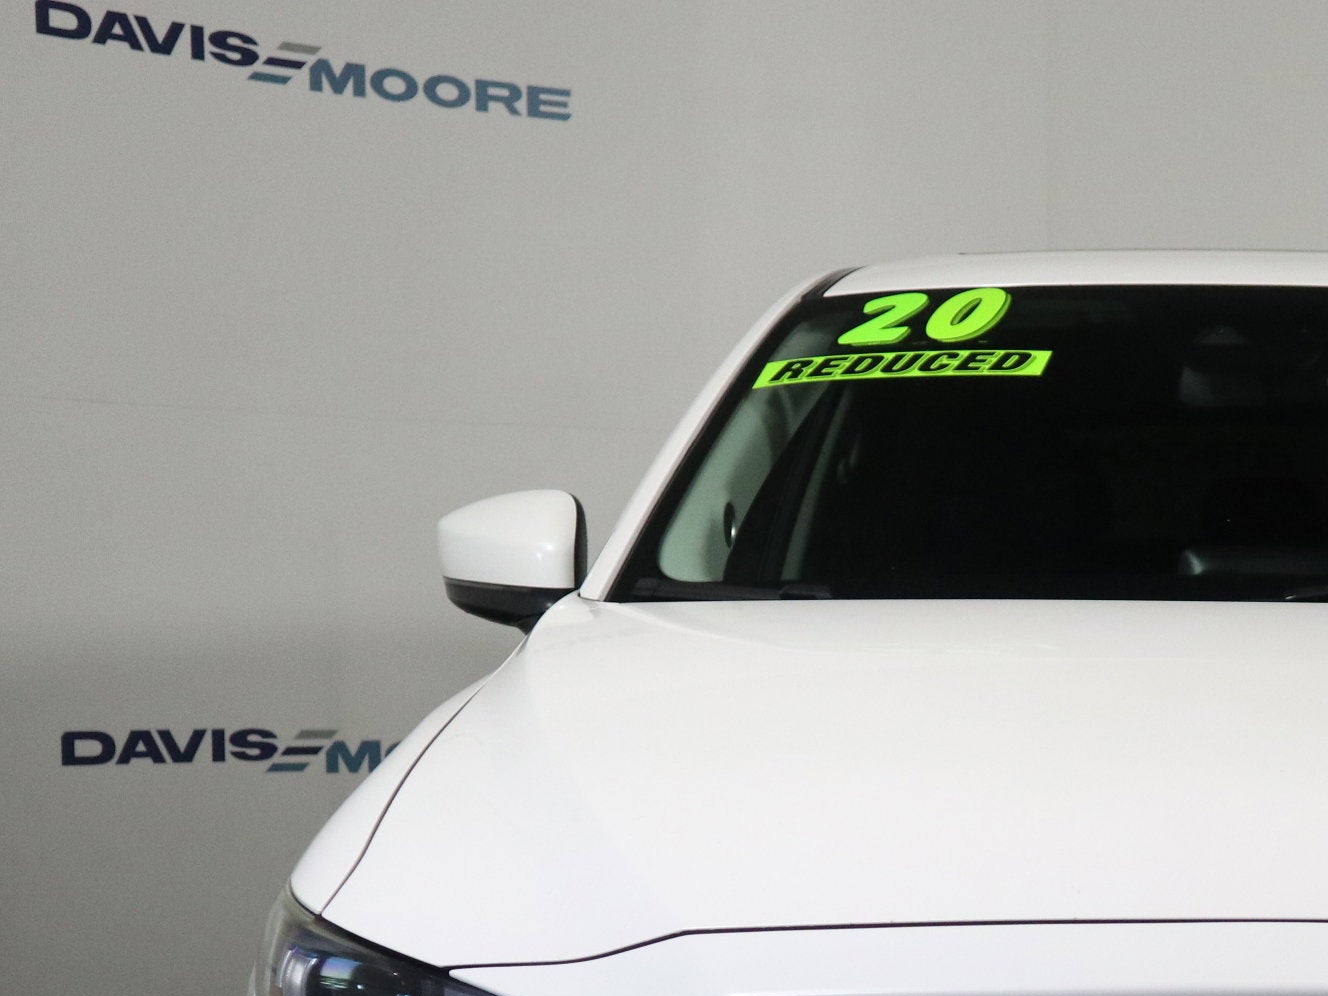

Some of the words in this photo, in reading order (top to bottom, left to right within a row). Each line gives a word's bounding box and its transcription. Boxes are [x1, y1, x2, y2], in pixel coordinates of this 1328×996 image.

[35, 0, 259, 67] DAVIS
[309, 59, 572, 121] MOORE
[837, 287, 1012, 345] 20
[768, 351, 1036, 384] REDUCED
[60, 728, 279, 766] DAVIS
